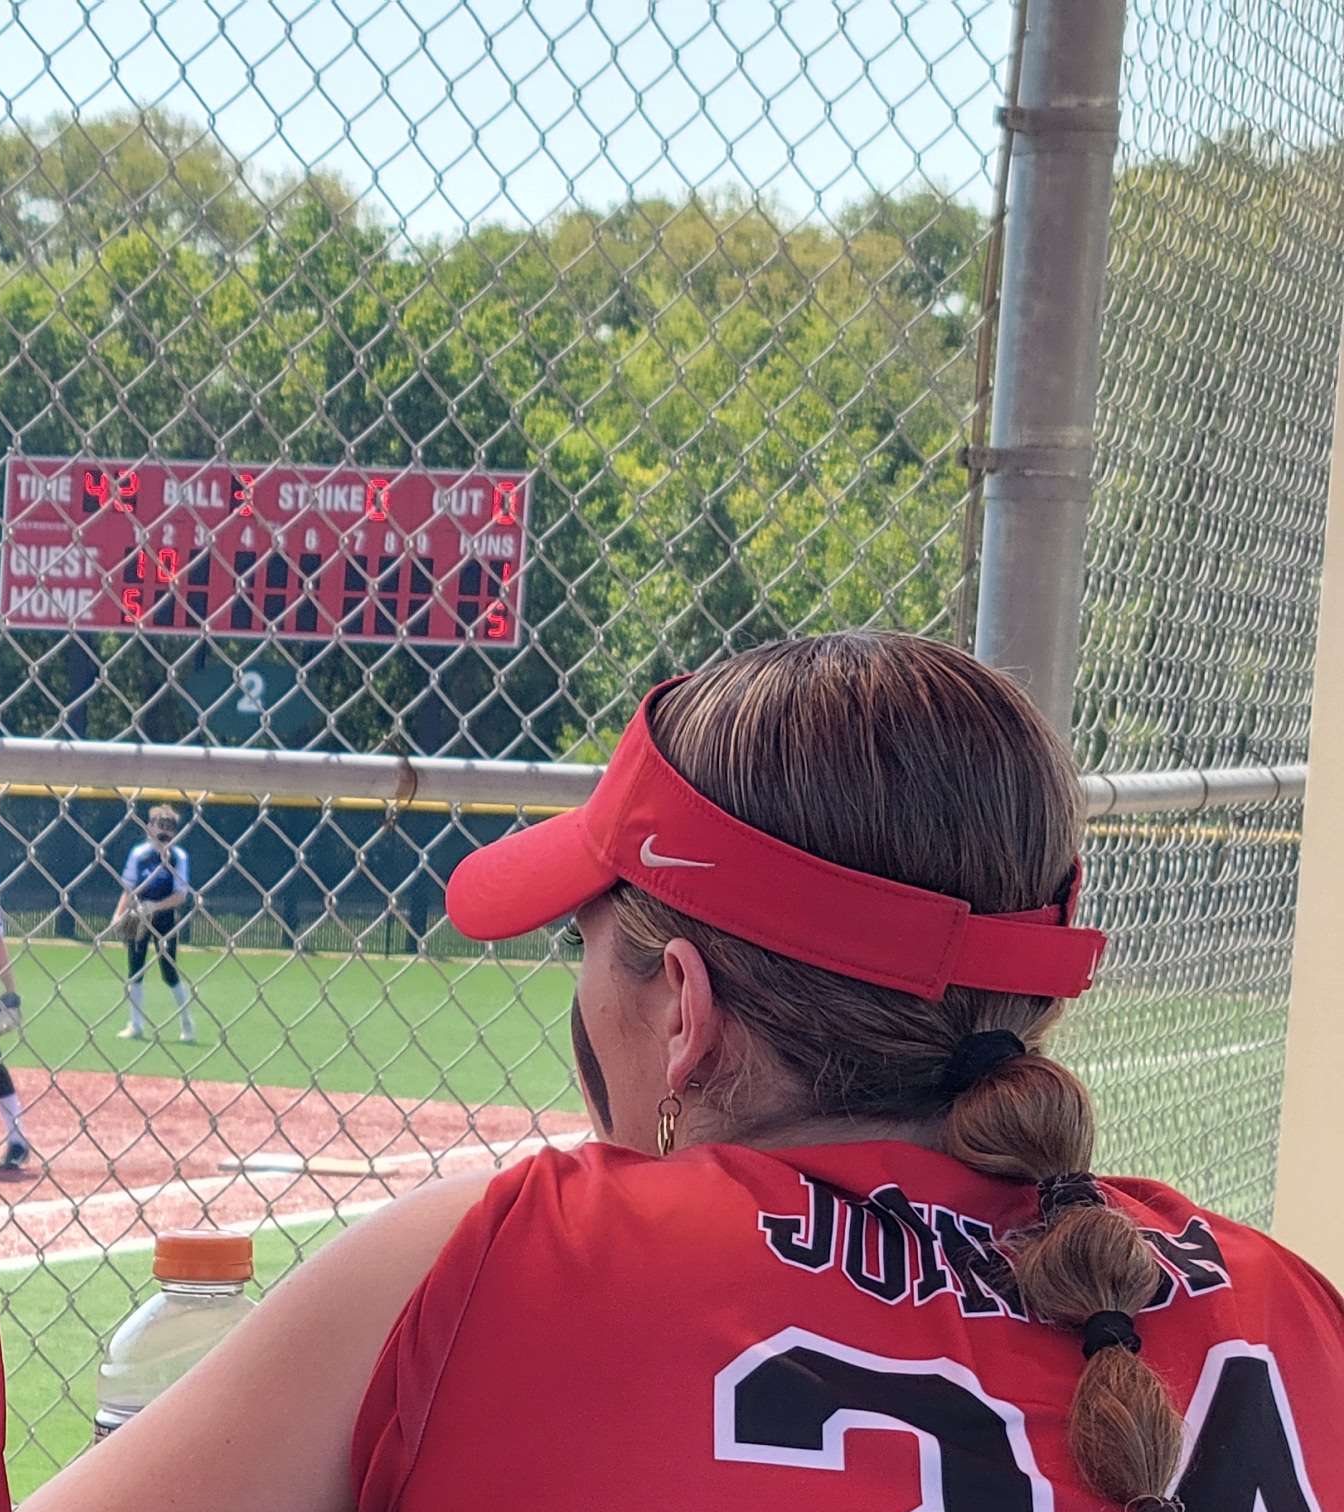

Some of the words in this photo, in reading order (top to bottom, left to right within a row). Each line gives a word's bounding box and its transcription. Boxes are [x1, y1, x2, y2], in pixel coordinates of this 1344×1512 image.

[16, 473, 72, 502] TIME
[163, 478, 224, 507] BALL
[432, 488, 484, 516] OUT
[162, 522, 176, 545] 2
[193, 523, 210, 547] 3
[240, 524, 255, 548] 4
[304, 527, 318, 550] 6
[353, 530, 367, 553] 7
[383, 531, 397, 553] 8
[415, 532, 430, 554] 9
[459, 533, 515, 558] RUNS
[9, 543, 99, 580] GUEST
[8, 585, 96, 620] HOME
[236, 670, 264, 712] 2
